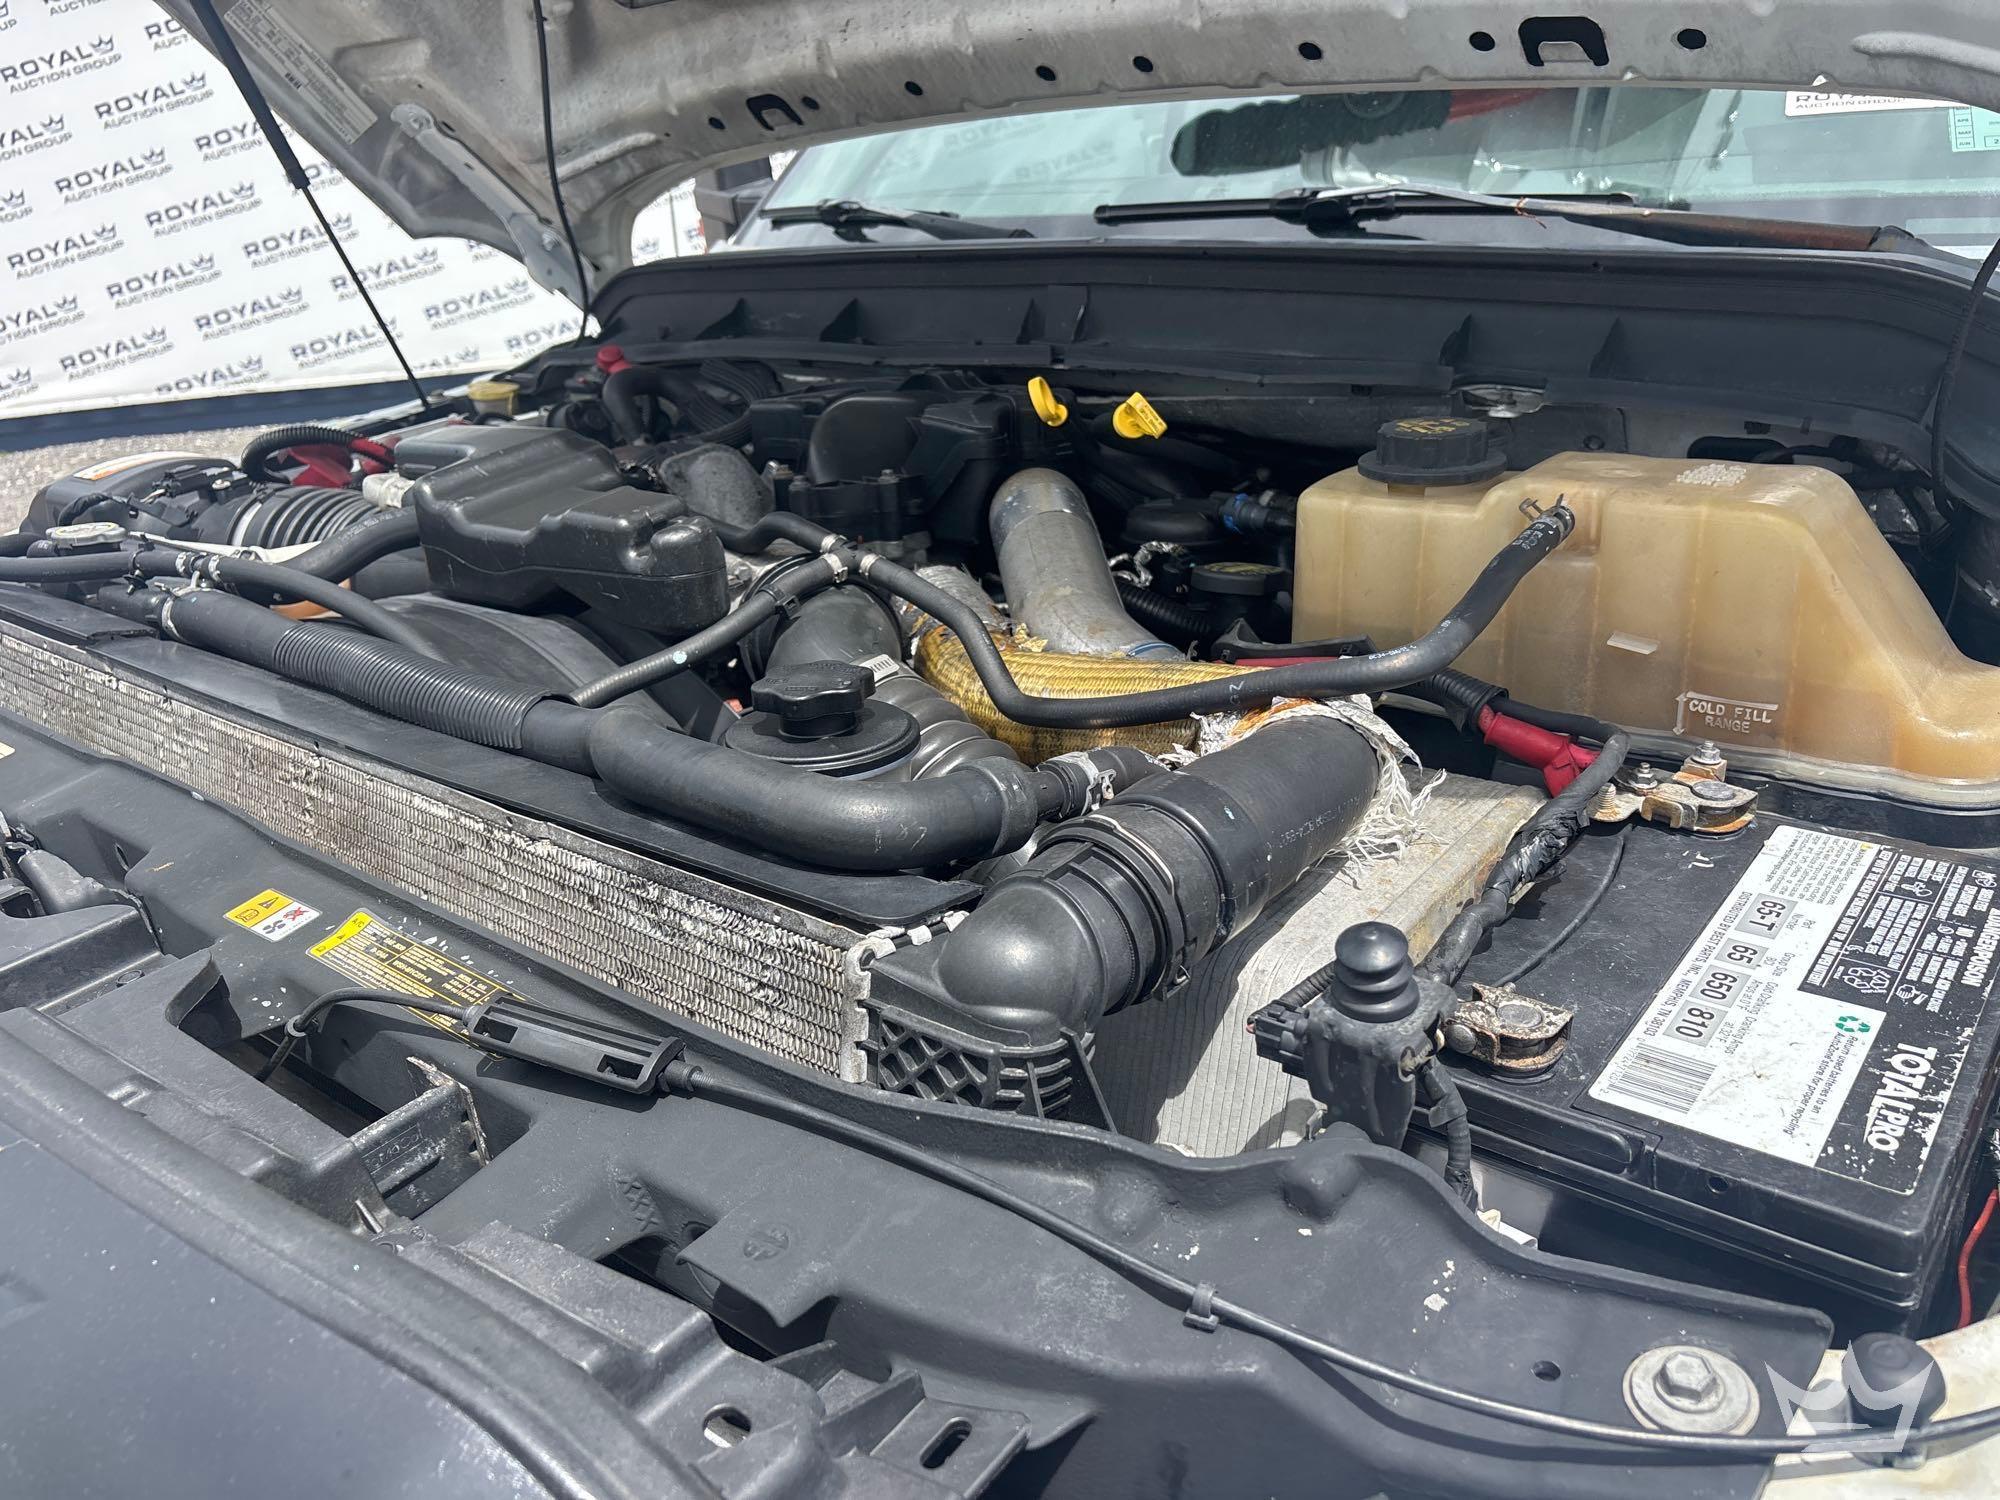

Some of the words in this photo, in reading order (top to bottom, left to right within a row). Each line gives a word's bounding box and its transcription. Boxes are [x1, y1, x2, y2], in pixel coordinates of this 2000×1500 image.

[0, 45, 93, 83] ROYAL
[10, 69, 71, 94] AUCTION
[73, 53, 122, 75] GROUP
[94, 82, 185, 119] ROYAL
[103, 107, 164, 130] AUCTION
[0, 124, 44, 148] YAL
[24, 132, 72, 153] GROUP
[195, 119, 262, 151] ROYA
[55, 156, 144, 193] ROYAL
[64, 180, 123, 204] AUCTION
[145, 189, 234, 227] ROYAL
[7, 233, 96, 270] ROYAL
[243, 223, 326, 258] ROYAL
[106, 262, 194, 299] ROYAL
[194, 296, 281, 331] ROYAL
[425, 286, 508, 320] ROYAL
[60, 336, 146, 373] ROYAL
[290, 325, 376, 360] ROYAL
[1689, 699, 1726, 716] COLD
[1734, 706, 1773, 724] FILL
[1704, 715, 1751, 734] RANGE
[1721, 891, 1753, 924] DISTRIBUTED
[1746, 899, 1787, 931] 65-T
[350, 917, 366, 928] A/C
[1716, 922, 1731, 931] BY
[1800, 918, 1816, 929] Part
[1706, 930, 1726, 945] BEST
[1690, 943, 1716, 965] PARTS,
[1724, 943, 1759, 964] 65
[1777, 951, 1796, 967] Group
[1771, 965, 1787, 977] Size
[1660, 977, 1692, 1009] MEMPHIS,
[1697, 970, 1739, 1001] 650
[1743, 978, 1763, 994] Amps
[1761, 980, 1779, 994] Cold
[1656, 1007, 1672, 1017] TN
[1745, 991, 1772, 1016] Cranking
[1642, 1016, 1666, 1037] 38103
[1672, 1006, 1716, 1039] 810
[1722, 1020, 1735, 1029] at
[1730, 1014, 1757, 1041] Cranking
[1721, 1037, 1743, 1055] Amps
[1839, 1035, 1858, 1055] Return
[1814, 1059, 1830, 1076] store
[1831, 1055, 1849, 1071] used
[1809, 1075, 1823, 1087] for
[1818, 1070, 1841, 1097] batteries
[1796, 1084, 1817, 1107] proper
[1814, 1097, 1828, 1106] to
[1780, 1105, 1808, 1137] recycling
[1810, 1104, 1822, 1114] an
